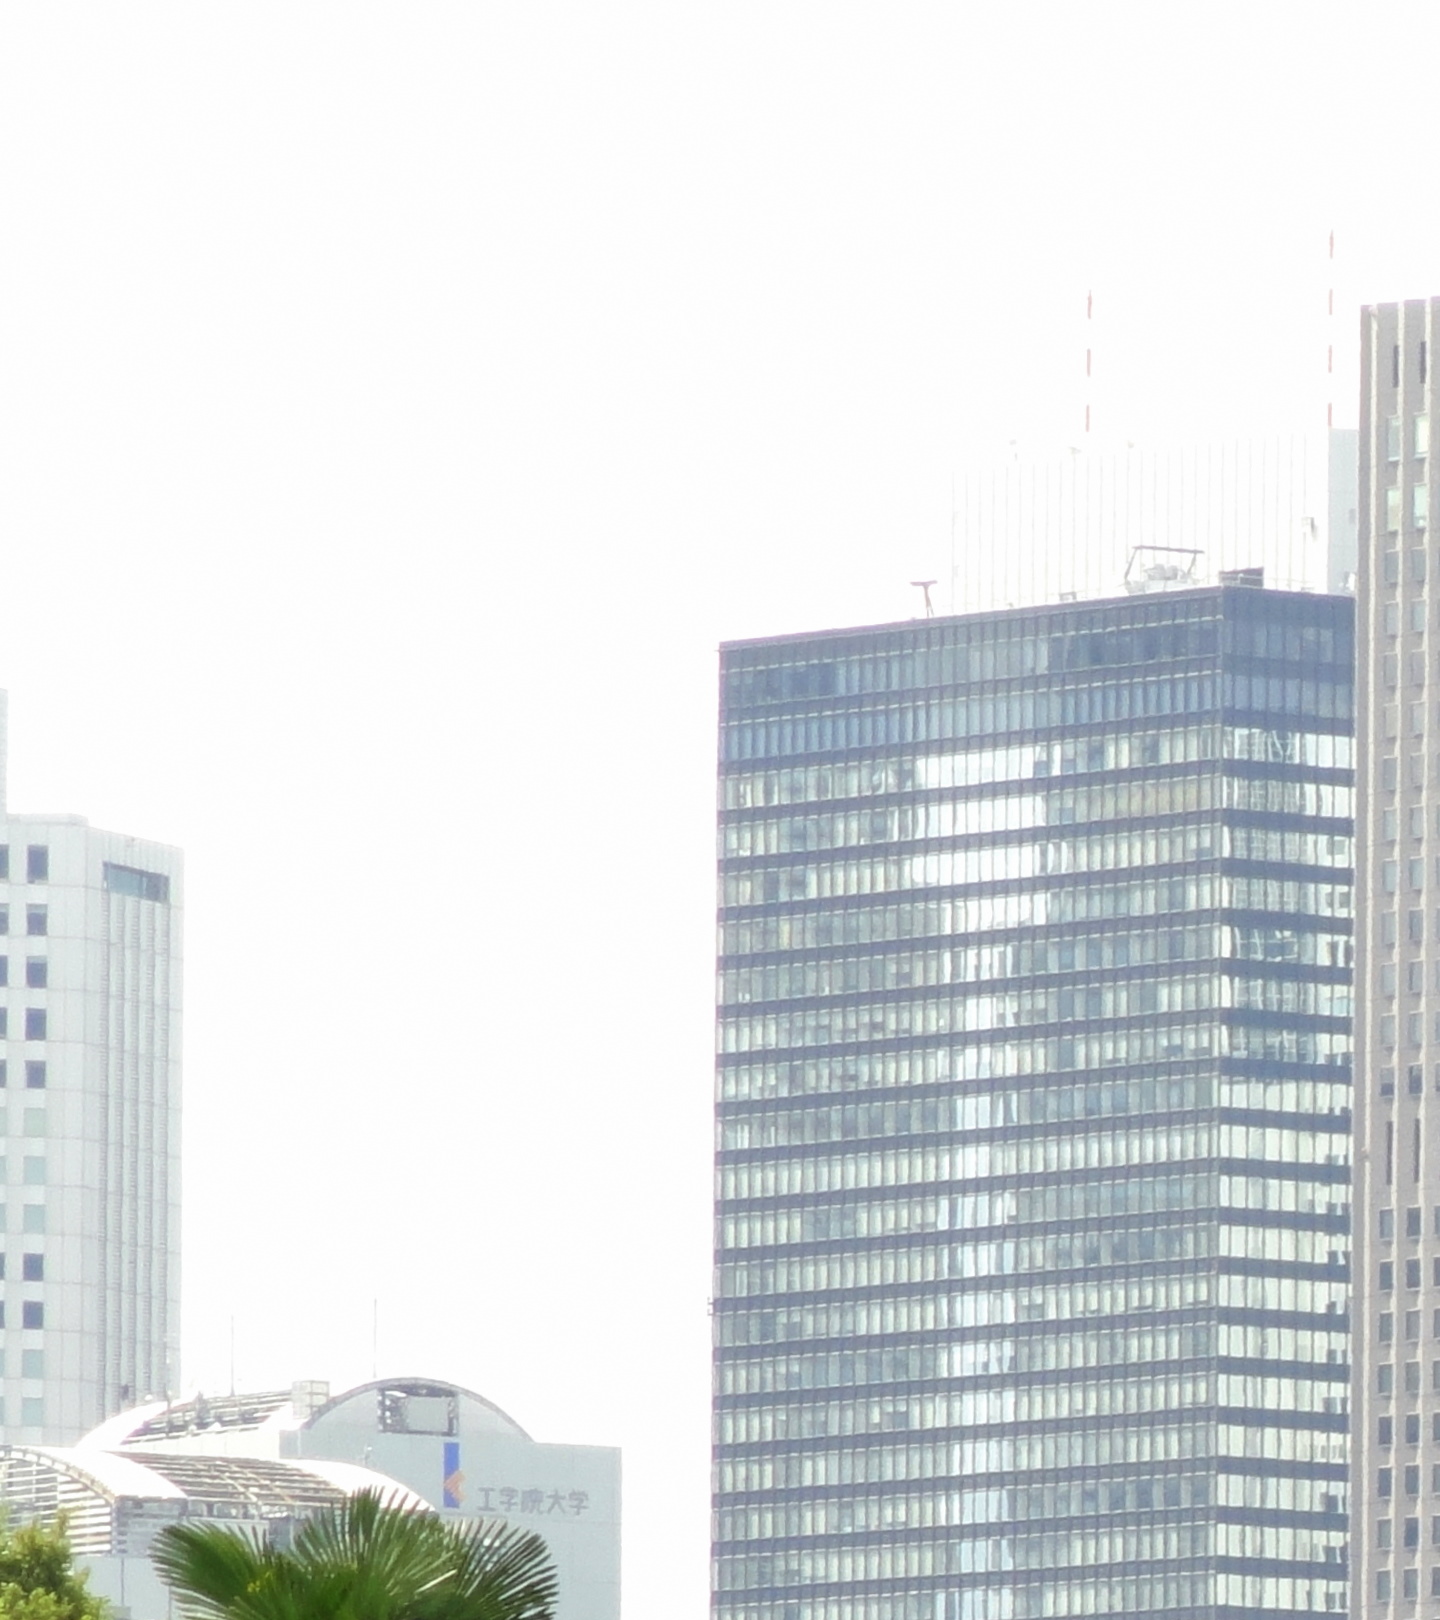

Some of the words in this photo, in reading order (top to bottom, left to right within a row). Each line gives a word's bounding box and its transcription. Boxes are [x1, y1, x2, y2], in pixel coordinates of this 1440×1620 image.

[477, 1486, 589, 1516] 工学院大学
